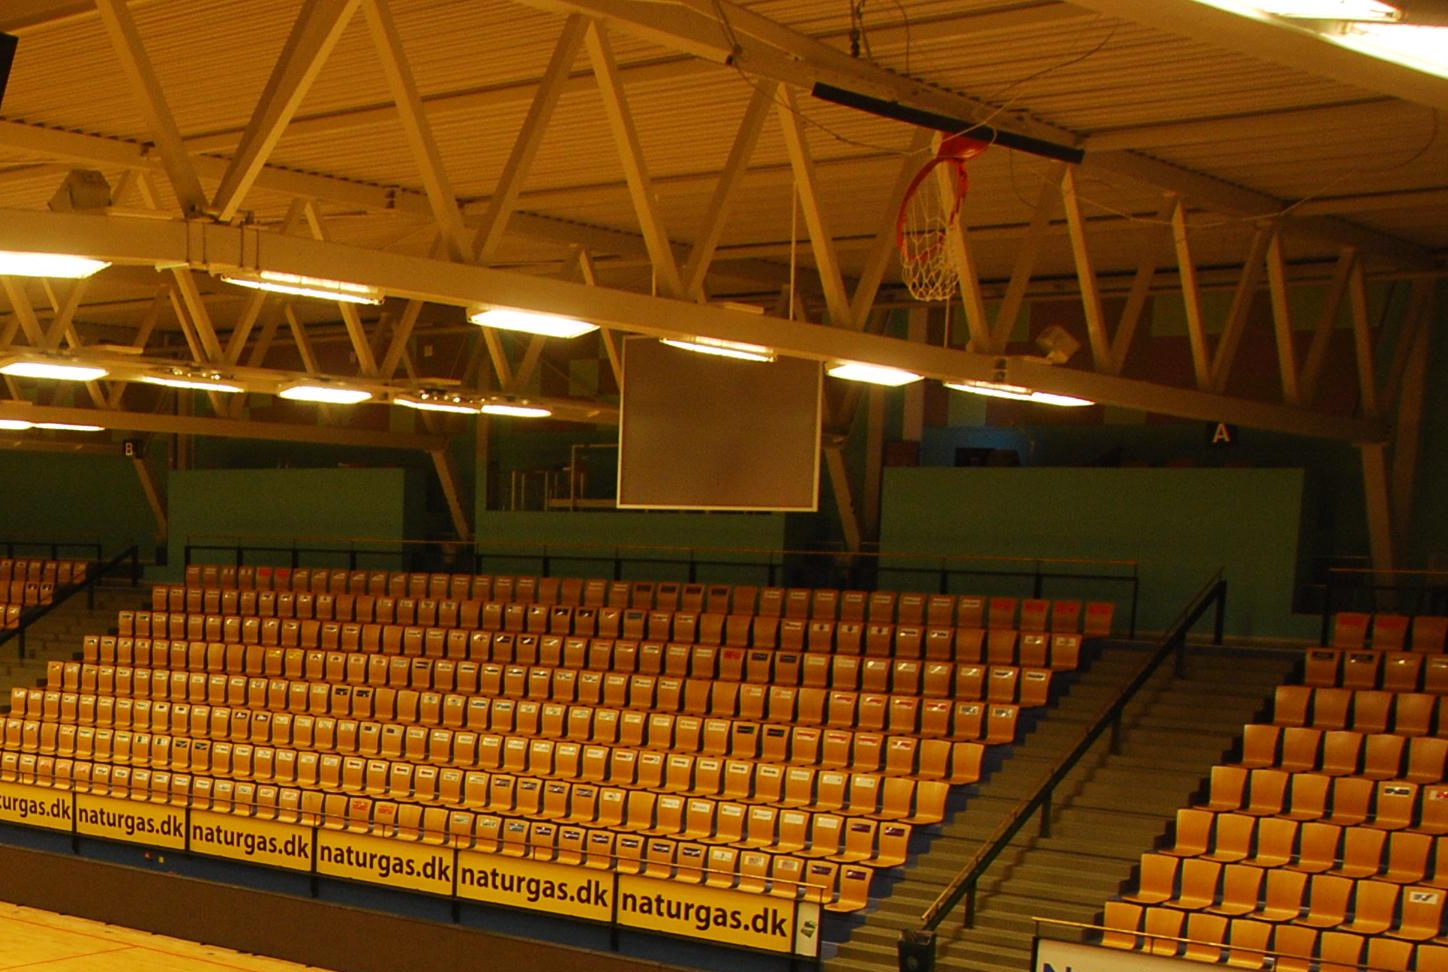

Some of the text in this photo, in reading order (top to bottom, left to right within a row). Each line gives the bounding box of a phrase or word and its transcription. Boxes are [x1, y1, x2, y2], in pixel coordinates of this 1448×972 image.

[1213, 423, 1230, 443] A
[78, 806, 184, 838] naturgas.dk
[192, 825, 309, 860] naturgas.dk
[319, 841, 451, 883] naturgas.dk
[460, 865, 608, 908] naturgas.dk
[621, 888, 788, 938] naturgas.dk
